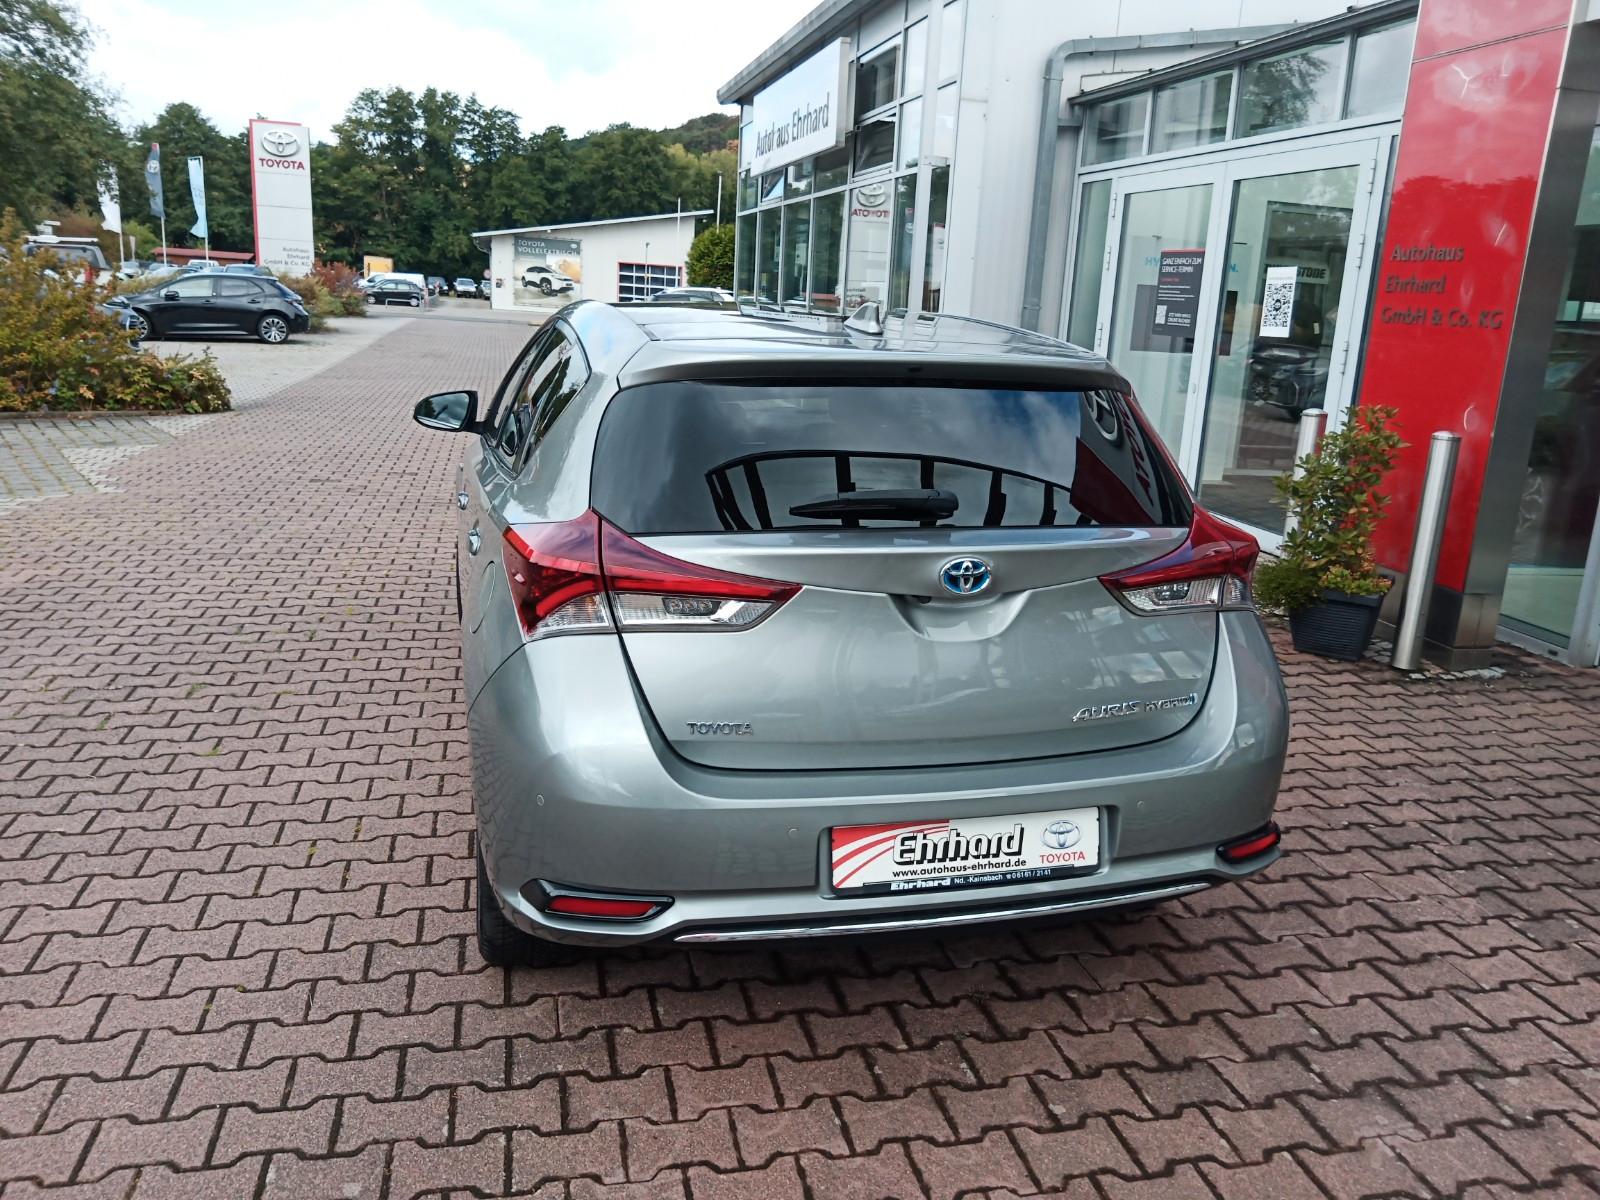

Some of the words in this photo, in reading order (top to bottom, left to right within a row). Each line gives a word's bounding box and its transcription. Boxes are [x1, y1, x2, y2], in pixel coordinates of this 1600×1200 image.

[791, 91, 830, 142] Ehrhard
[259, 158, 305, 170] TOYOTA
[1392, 245, 1464, 261] Autohaus
[1385, 274, 1447, 294] Ehrhard
[1381, 306, 1427, 325] GmbH
[1431, 308, 1442, 327] &
[1448, 308, 1472, 328] Co.
[1477, 310, 1503, 330] KG
[1072, 700, 1141, 722] AURIS
[686, 721, 753, 735] TOYOTA
[893, 823, 1025, 866] Ehrhard
[892, 857, 1027, 878] www.autohaus-ehrhard.de
[1040, 851, 1085, 864] TOYOTA
[890, 877, 951, 891] Ehrhard
